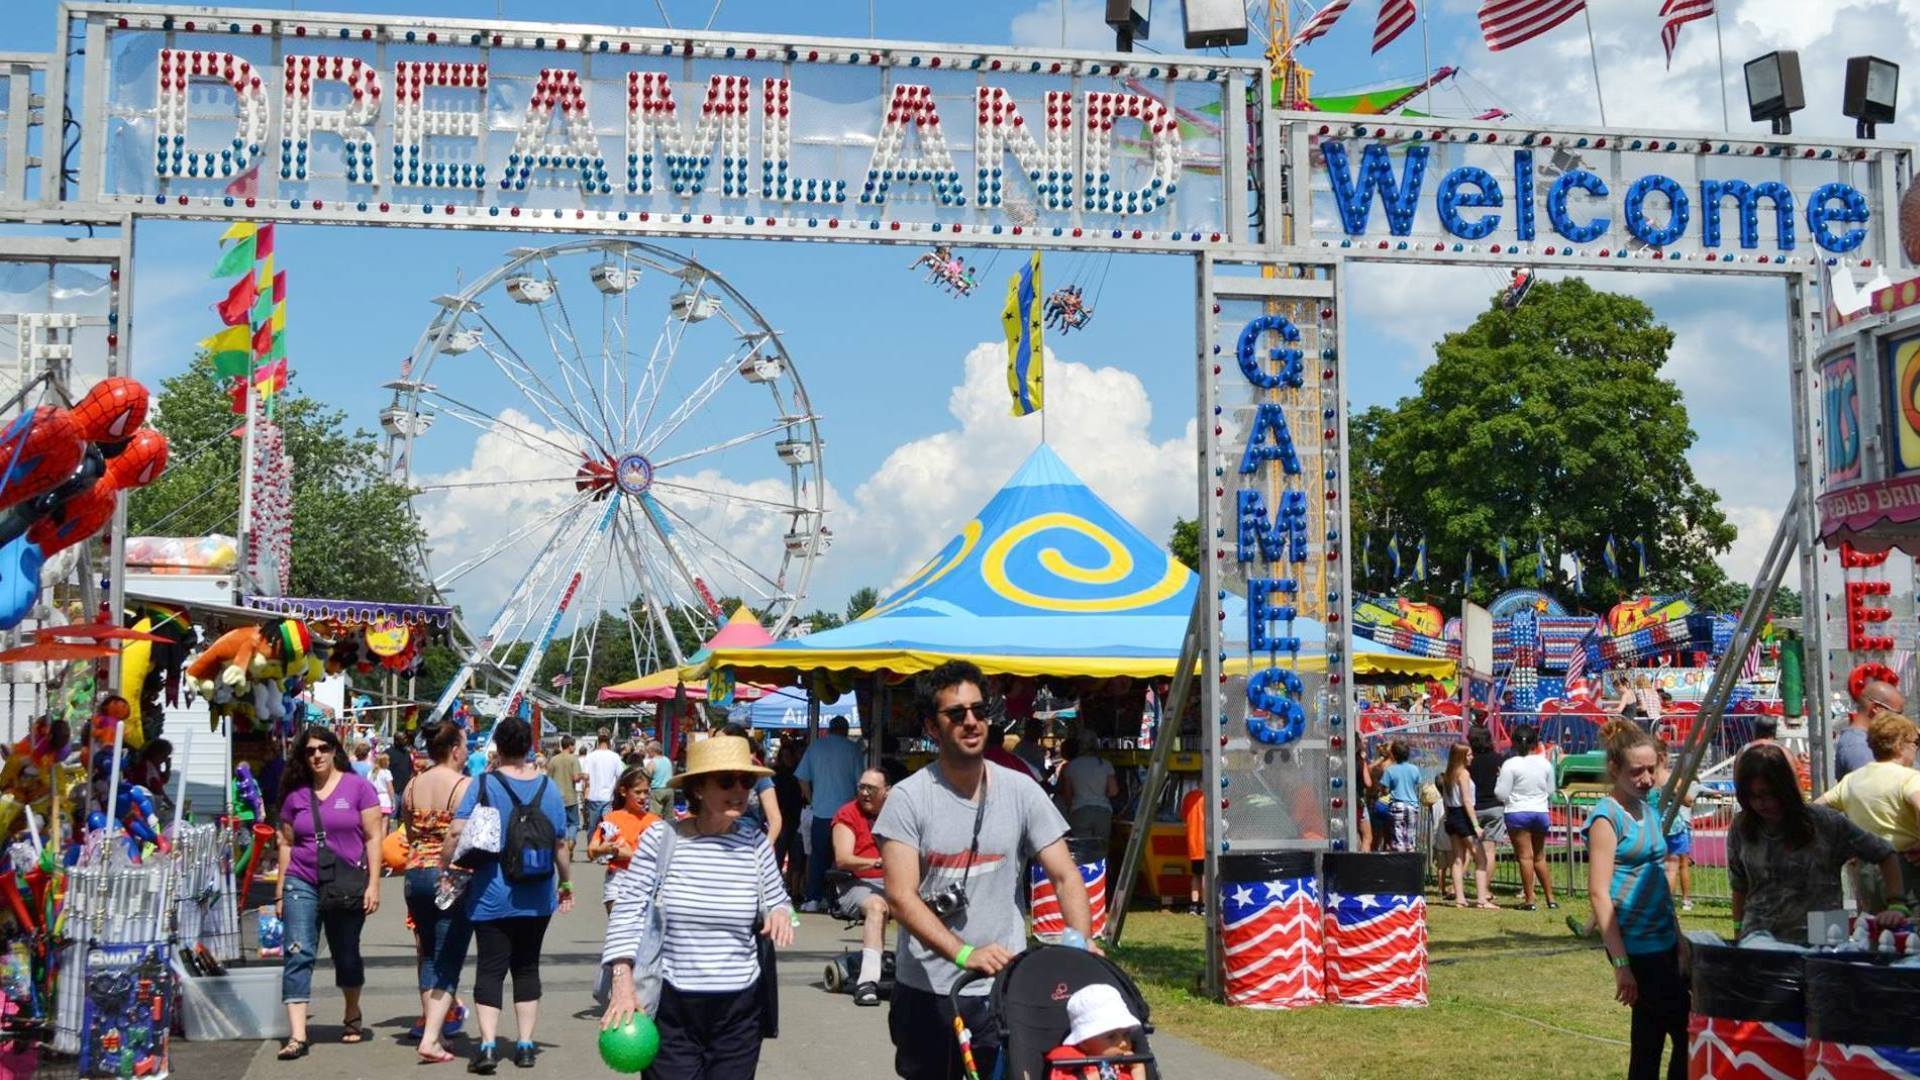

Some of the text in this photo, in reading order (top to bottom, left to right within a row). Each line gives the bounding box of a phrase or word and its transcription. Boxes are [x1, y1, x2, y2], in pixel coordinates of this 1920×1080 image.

[154, 48, 1184, 214] DREAMLAND
[1320, 141, 1870, 253] Welcome
[1236, 314, 1307, 745] GAMES
